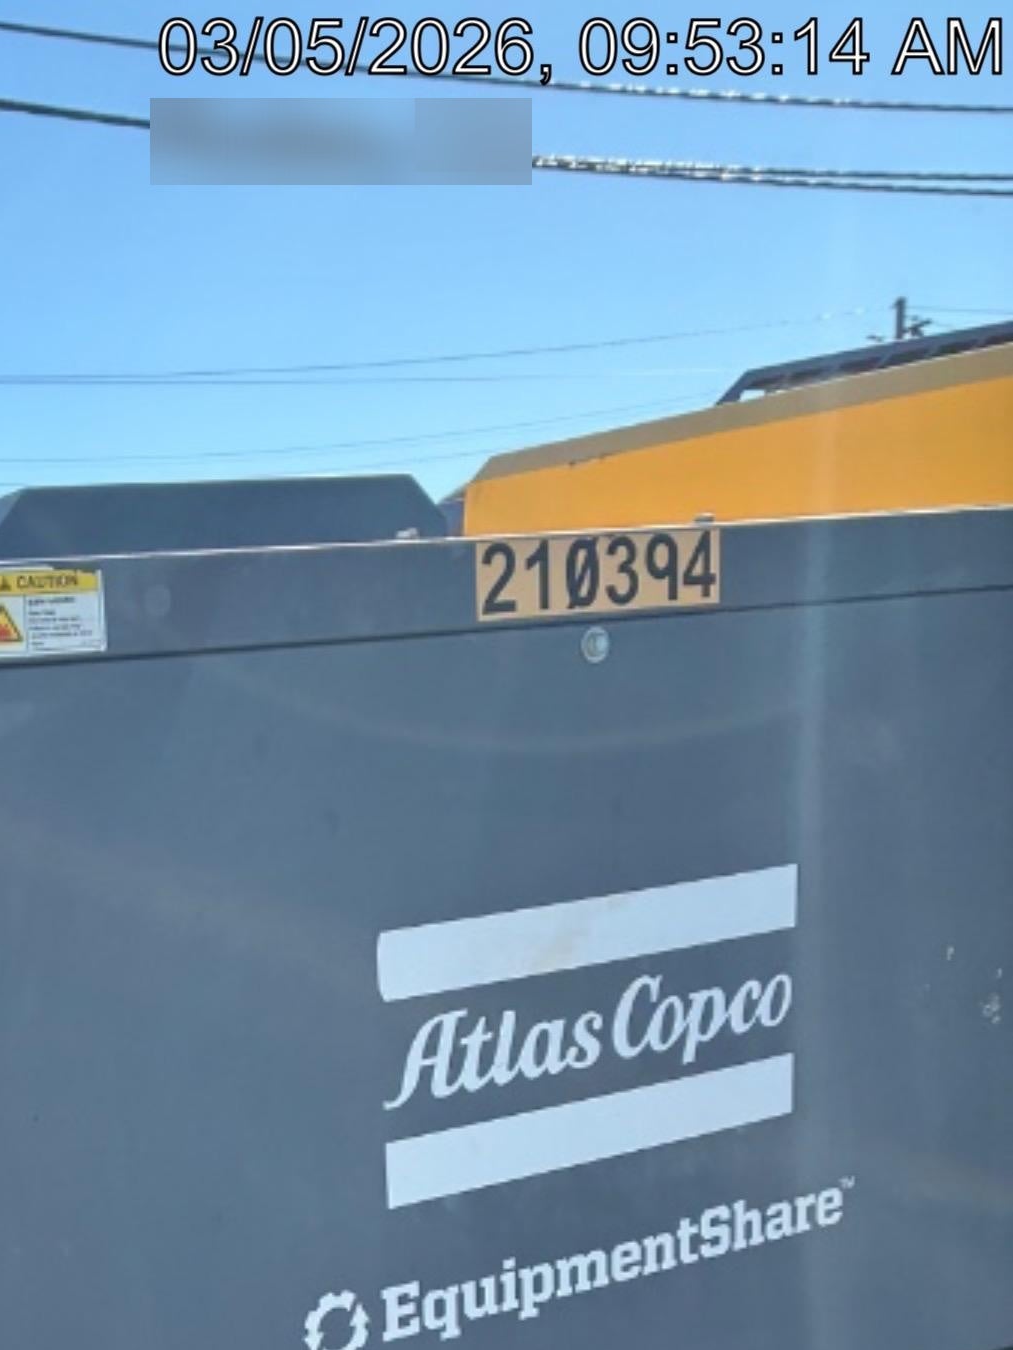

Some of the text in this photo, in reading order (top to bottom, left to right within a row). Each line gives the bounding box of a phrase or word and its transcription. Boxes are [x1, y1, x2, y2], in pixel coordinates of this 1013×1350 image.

[16, 573, 78, 590] CAUTION
[481, 530, 716, 615] 210394
[383, 974, 793, 1111] Atlas Copco
[381, 1186, 844, 1342] EquipmentShare
